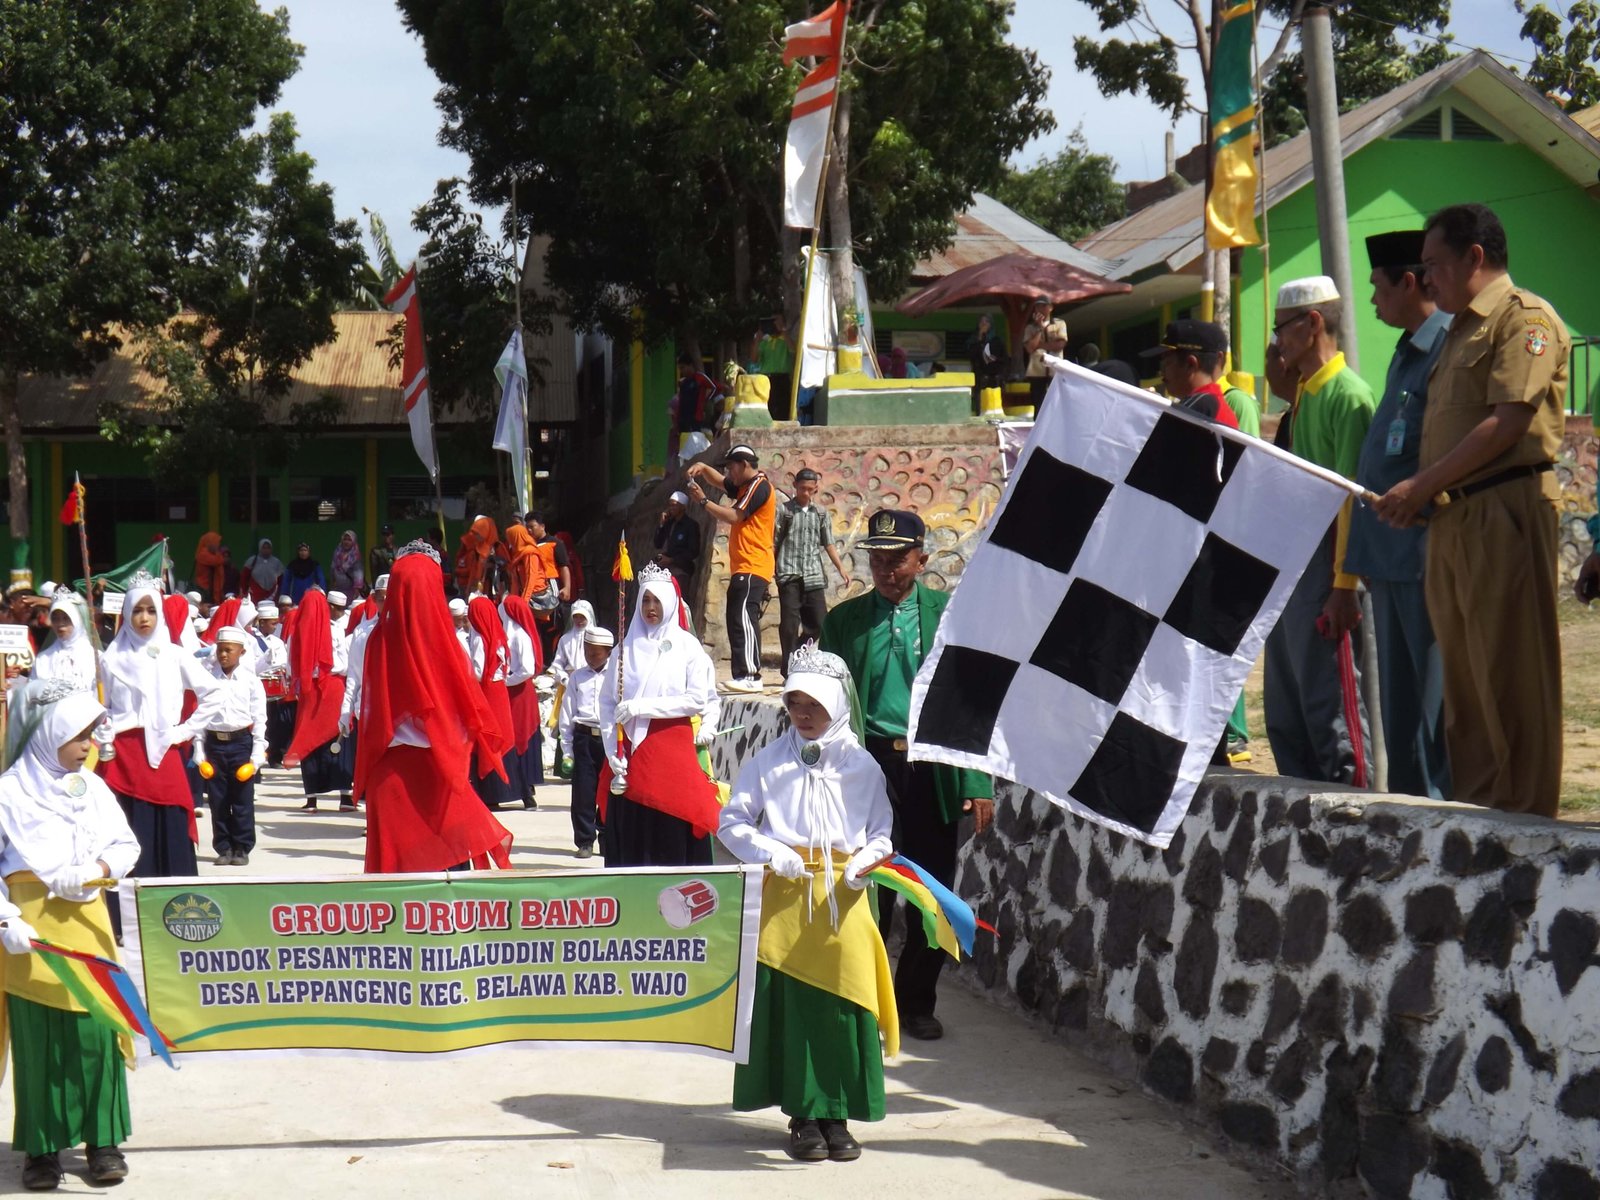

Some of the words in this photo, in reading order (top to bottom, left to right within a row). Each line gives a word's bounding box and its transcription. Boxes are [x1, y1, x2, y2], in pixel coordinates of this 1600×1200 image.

[271, 903, 395, 934] GROUP
[404, 900, 510, 935] DRUM
[521, 898, 619, 929] BAND
[181, 949, 271, 973] PONDOK
[278, 947, 413, 970] PESANTREN
[420, 941, 555, 972] HILALUDDIN
[563, 938, 706, 963] BOLAASEARE
[201, 982, 260, 1006] DESA
[267, 980, 412, 1006] LEPPANGENG
[420, 982, 468, 1006] KEC.
[477, 973, 566, 1000] BELAWA
[574, 972, 622, 996] KAB.
[631, 972, 688, 997] WAJO
